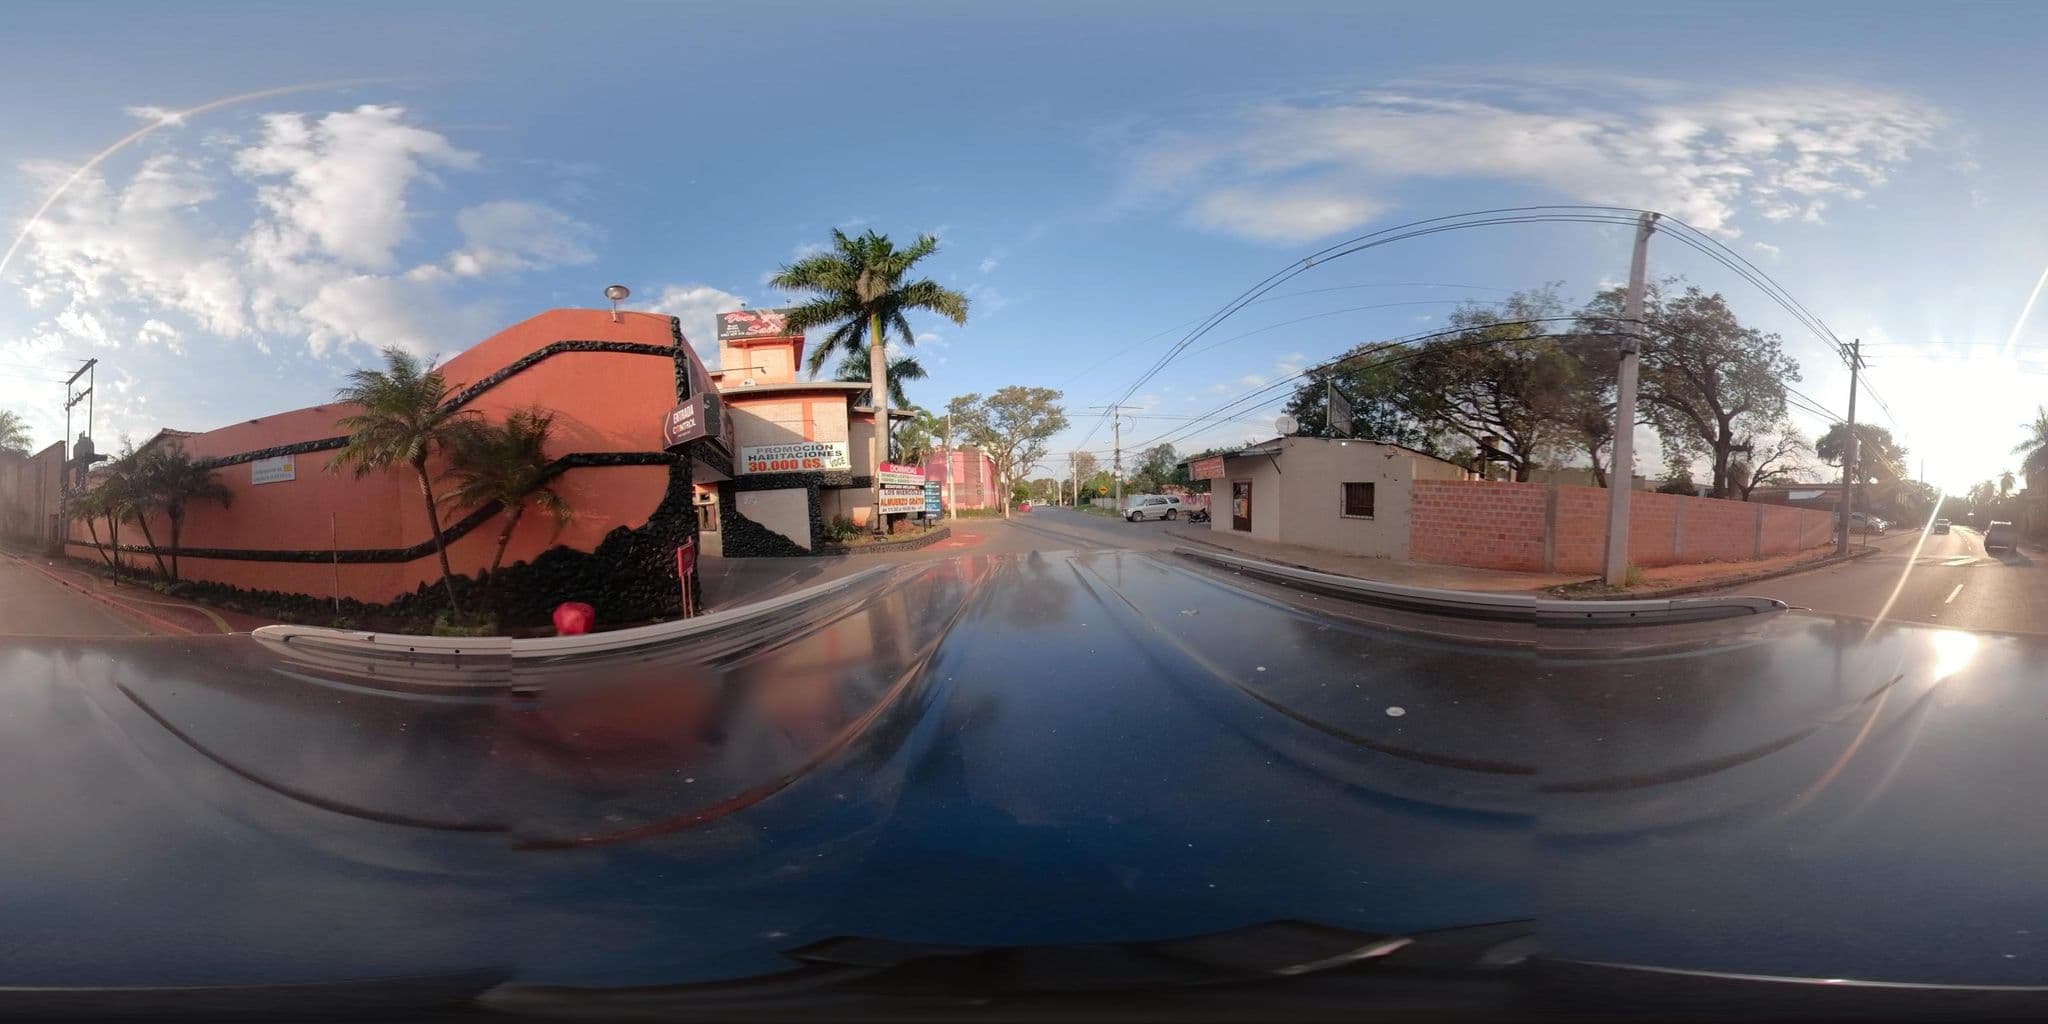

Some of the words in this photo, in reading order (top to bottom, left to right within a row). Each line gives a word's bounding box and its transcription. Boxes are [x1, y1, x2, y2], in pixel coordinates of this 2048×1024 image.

[673, 404, 694, 424] ENTRADA
[673, 417, 697, 434] CONTROL
[748, 450, 842, 461] HABITACIONES
[748, 459, 799, 472] 30.000
